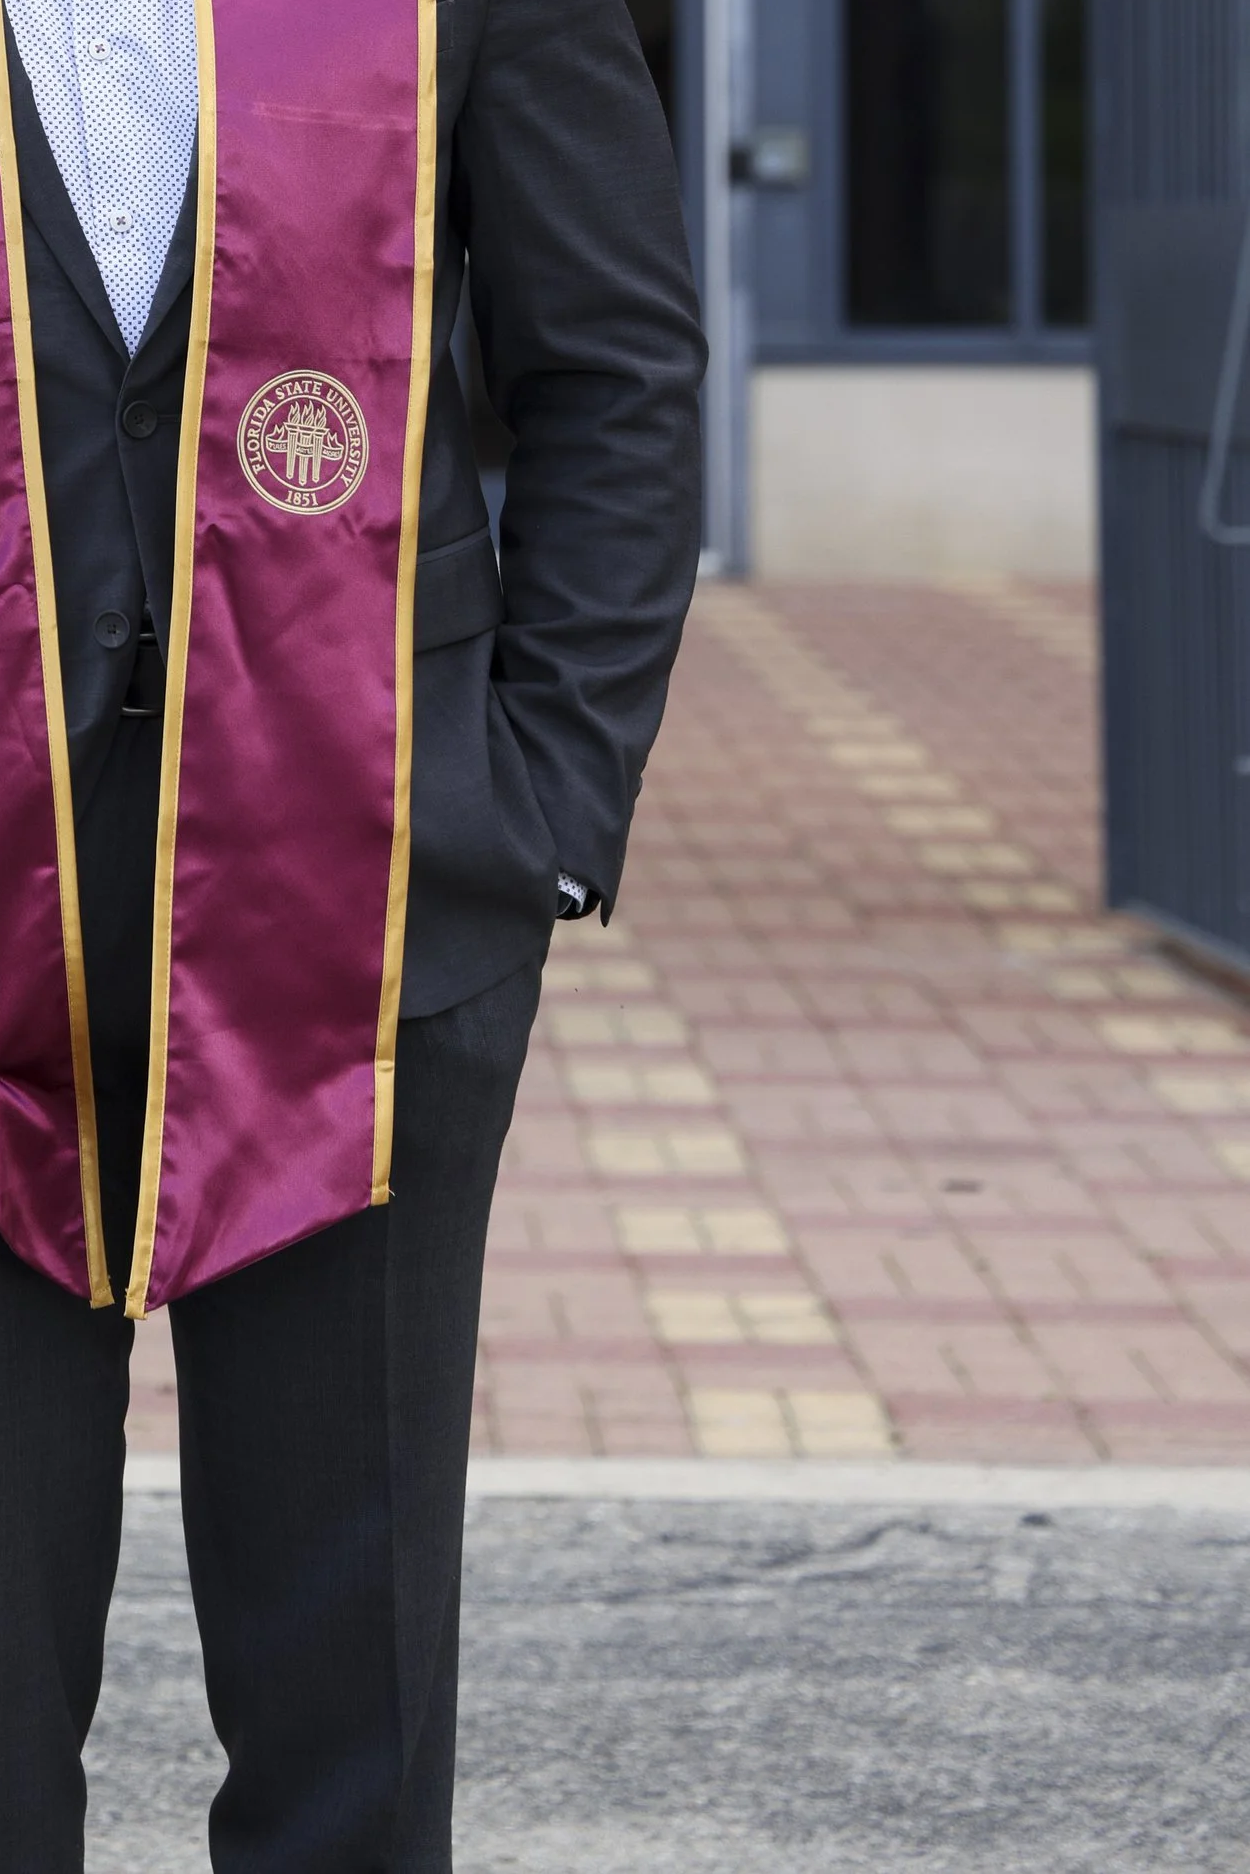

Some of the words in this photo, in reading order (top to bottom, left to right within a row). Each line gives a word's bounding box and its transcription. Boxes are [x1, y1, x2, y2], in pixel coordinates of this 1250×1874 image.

[248, 399, 275, 474] FLORIDA
[276, 380, 323, 400] STATE
[327, 389, 361, 487] UNIVERSITY
[285, 491, 318, 506] 1851
